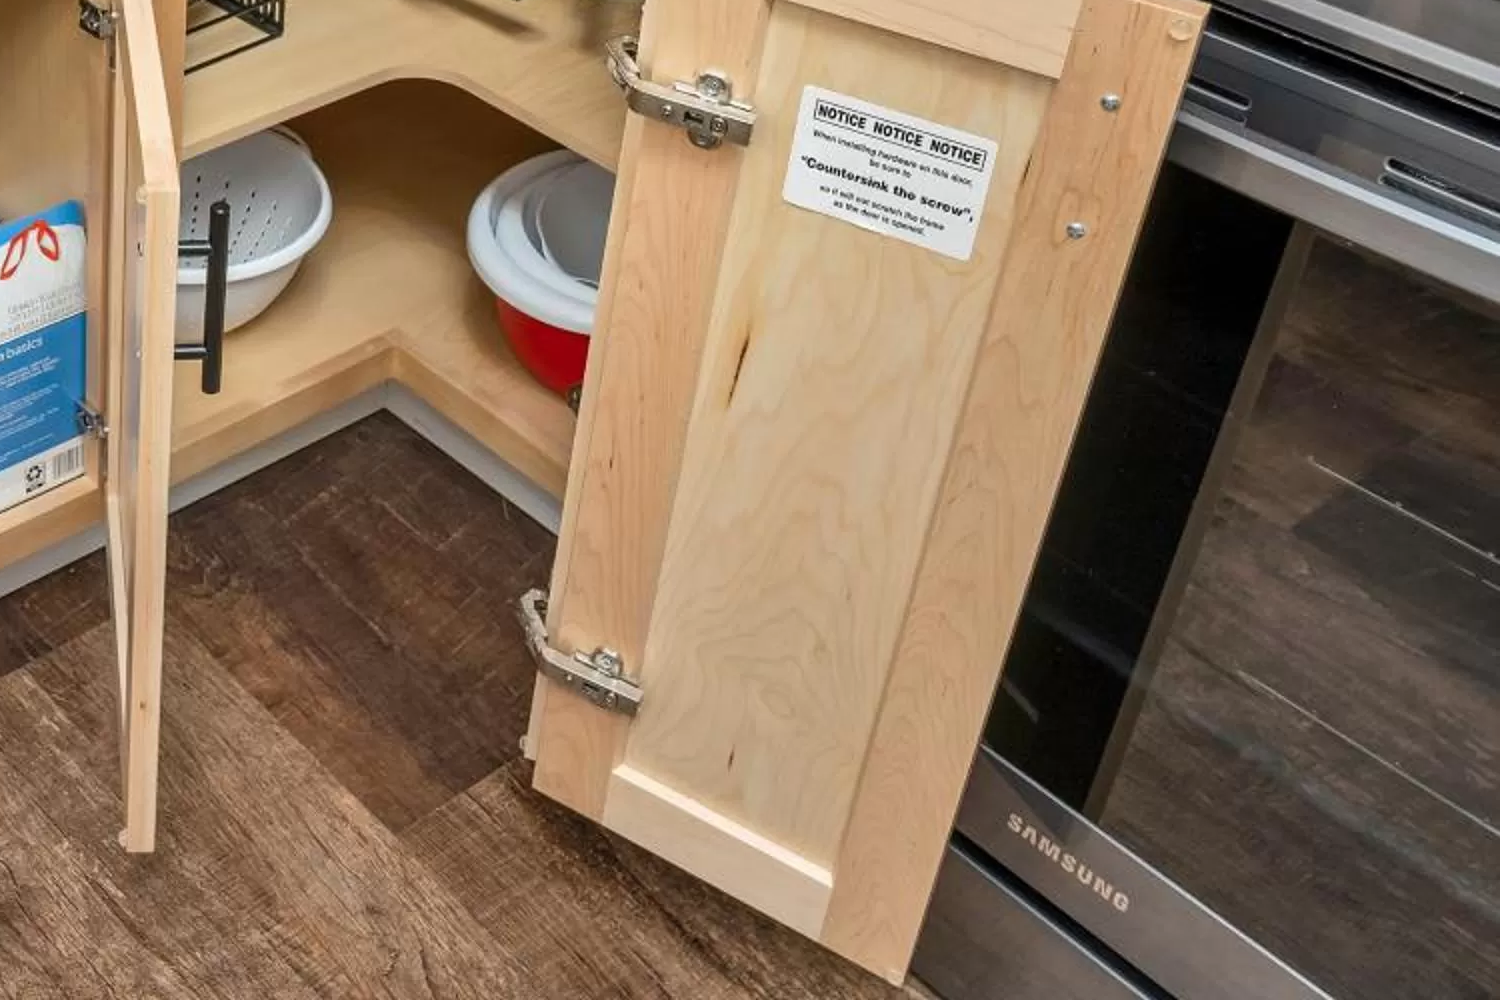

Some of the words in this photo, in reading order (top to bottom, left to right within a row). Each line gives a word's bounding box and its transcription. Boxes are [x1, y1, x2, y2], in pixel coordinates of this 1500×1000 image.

[818, 104, 867, 129] NOTICE
[873, 121, 923, 147] NOTICE
[930, 138, 982, 165] NOTICE
[893, 185, 917, 201] the
[4, 336, 44, 360] basics
[1007, 812, 1130, 912] SAMSUNG
